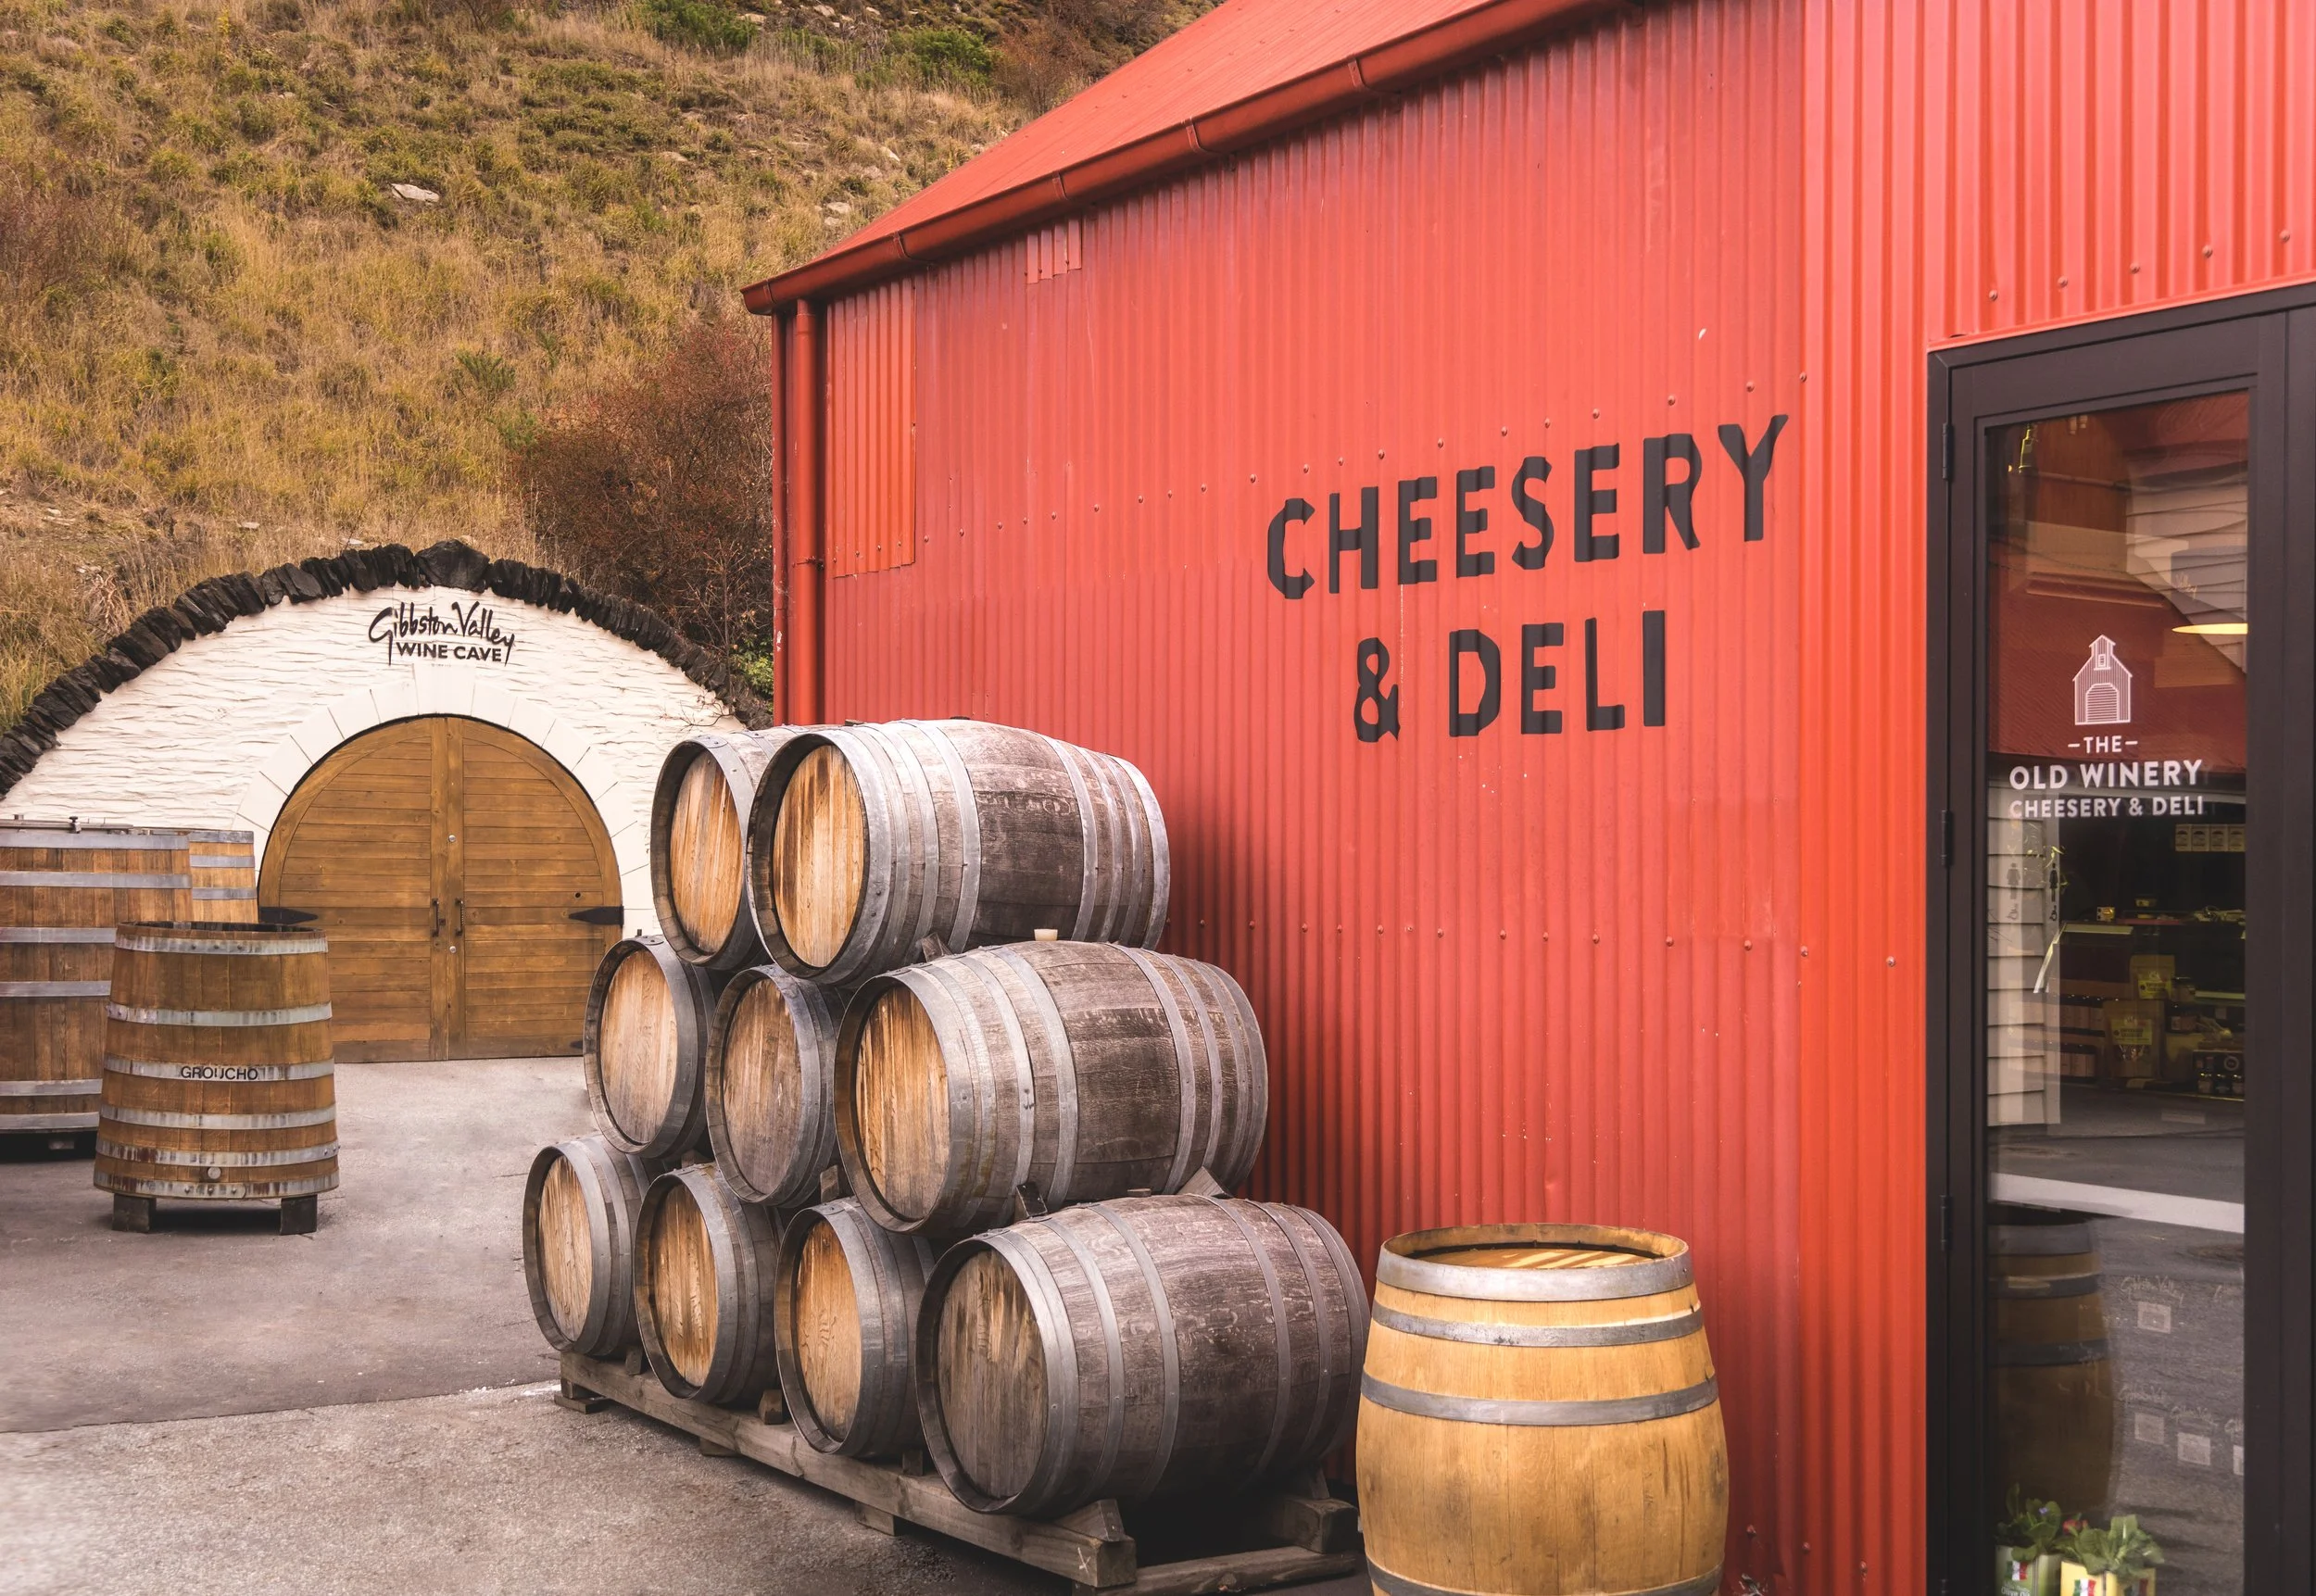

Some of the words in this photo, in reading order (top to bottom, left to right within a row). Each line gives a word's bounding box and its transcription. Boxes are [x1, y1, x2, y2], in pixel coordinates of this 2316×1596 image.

[1267, 413, 1789, 600] CHEESERY
[368, 602, 458, 666] Gibbston
[451, 601, 516, 667] Valley
[396, 642, 448, 660] WINE
[453, 646, 502, 662] CAVE
[1353, 636, 1401, 743] &
[1448, 609, 1666, 738] DELI
[2009, 765, 2068, 790] OLD
[2080, 759, 2203, 788] WINERY
[2009, 798, 2121, 818] CHEESERY
[2128, 798, 2143, 816] &
[2152, 795, 2204, 816] DELI
[181, 1065, 258, 1081] GROUCHO
